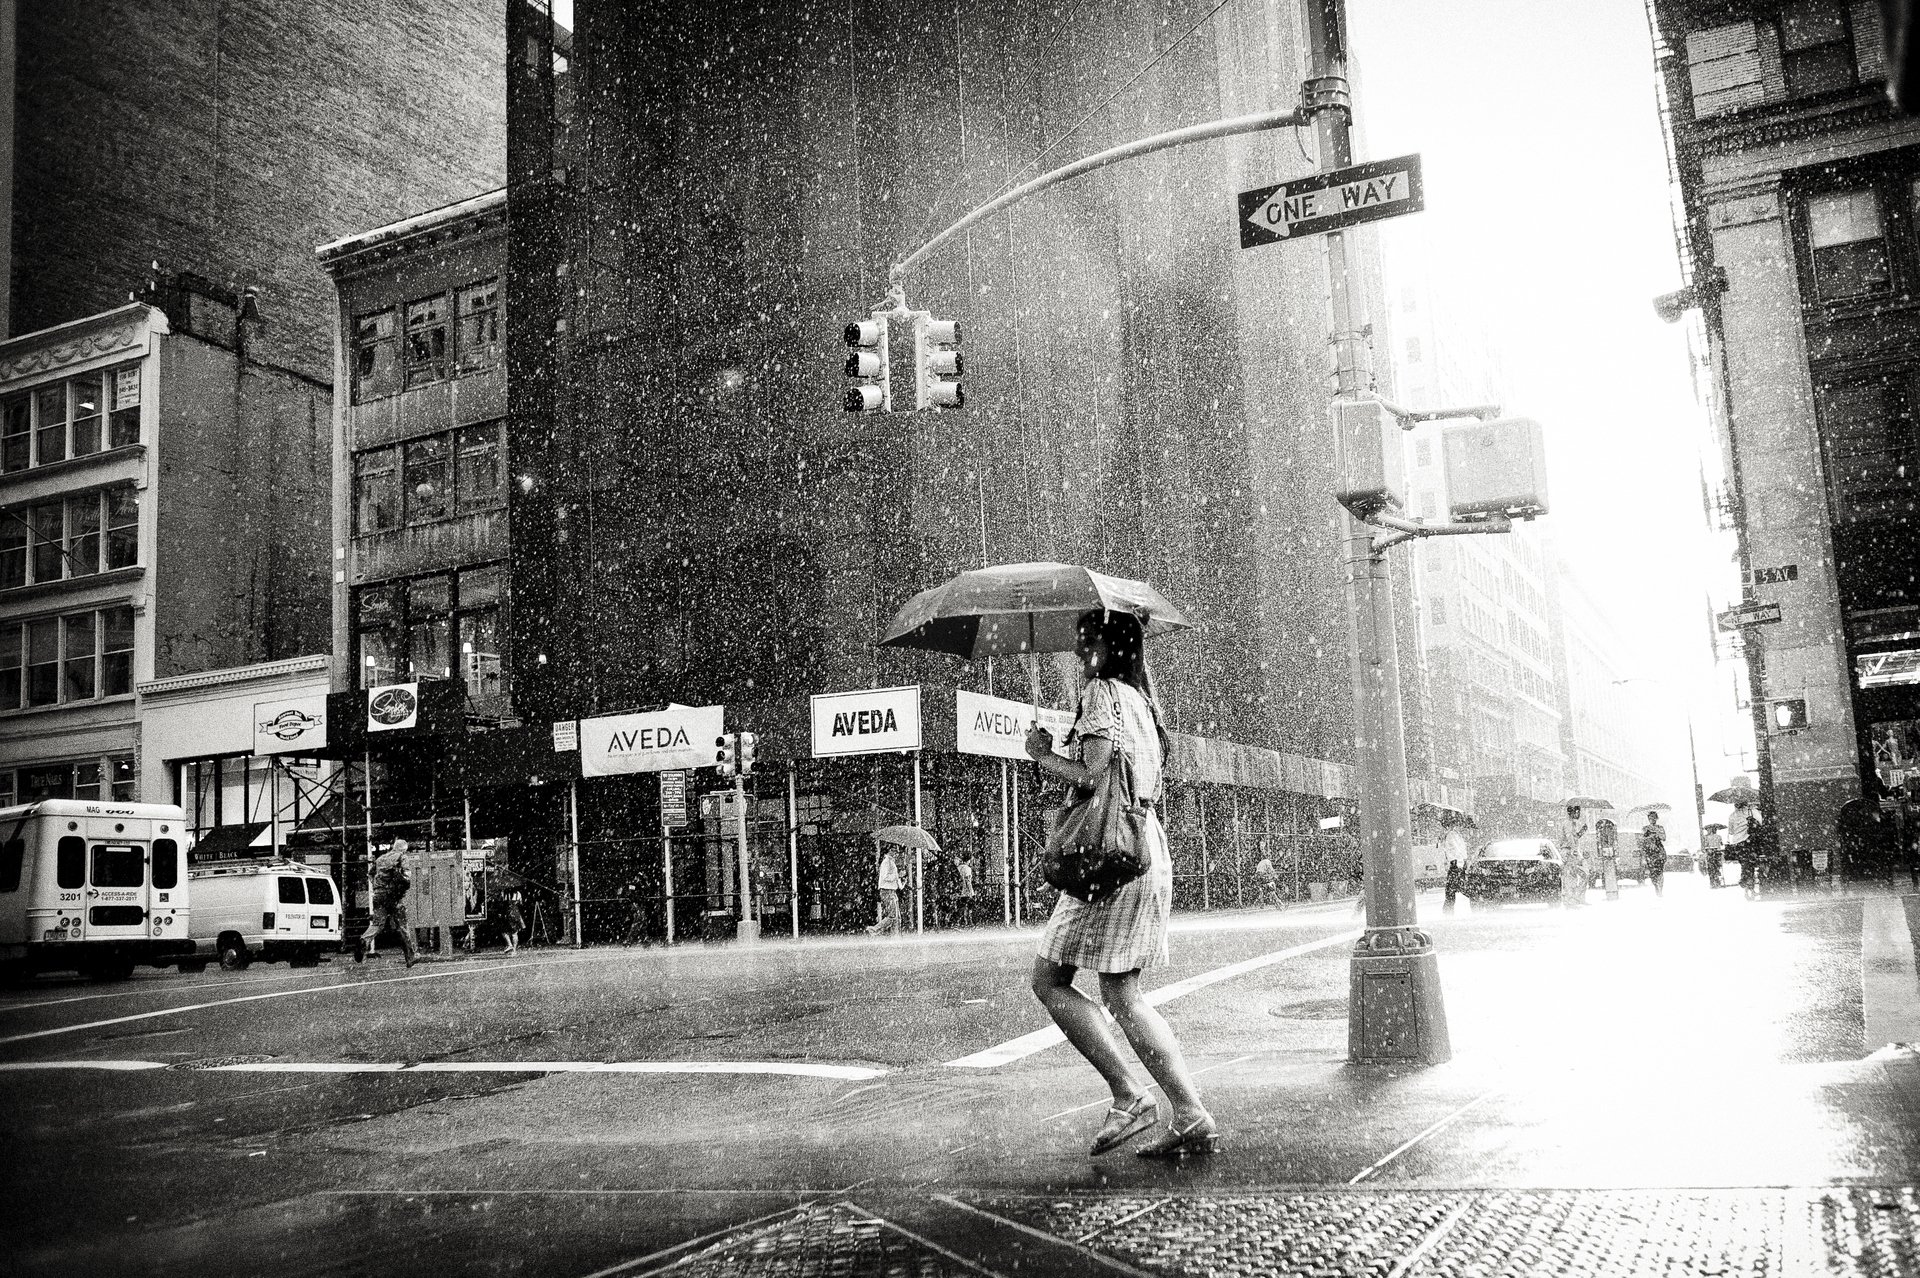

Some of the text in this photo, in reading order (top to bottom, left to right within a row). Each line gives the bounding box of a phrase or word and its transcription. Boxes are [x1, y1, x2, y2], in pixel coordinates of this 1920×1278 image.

[1266, 176, 1397, 225] ONE WAY
[1762, 568, 1789, 584] 5 AV
[1752, 610, 1771, 621] WAY
[832, 707, 899, 737] AVEDA
[974, 710, 1022, 737] AVEDA
[607, 726, 691, 753] AVEDA
[86, 805, 100, 814] MAG
[219, 851, 238, 859] BLACK
[59, 892, 81, 901] 3201
